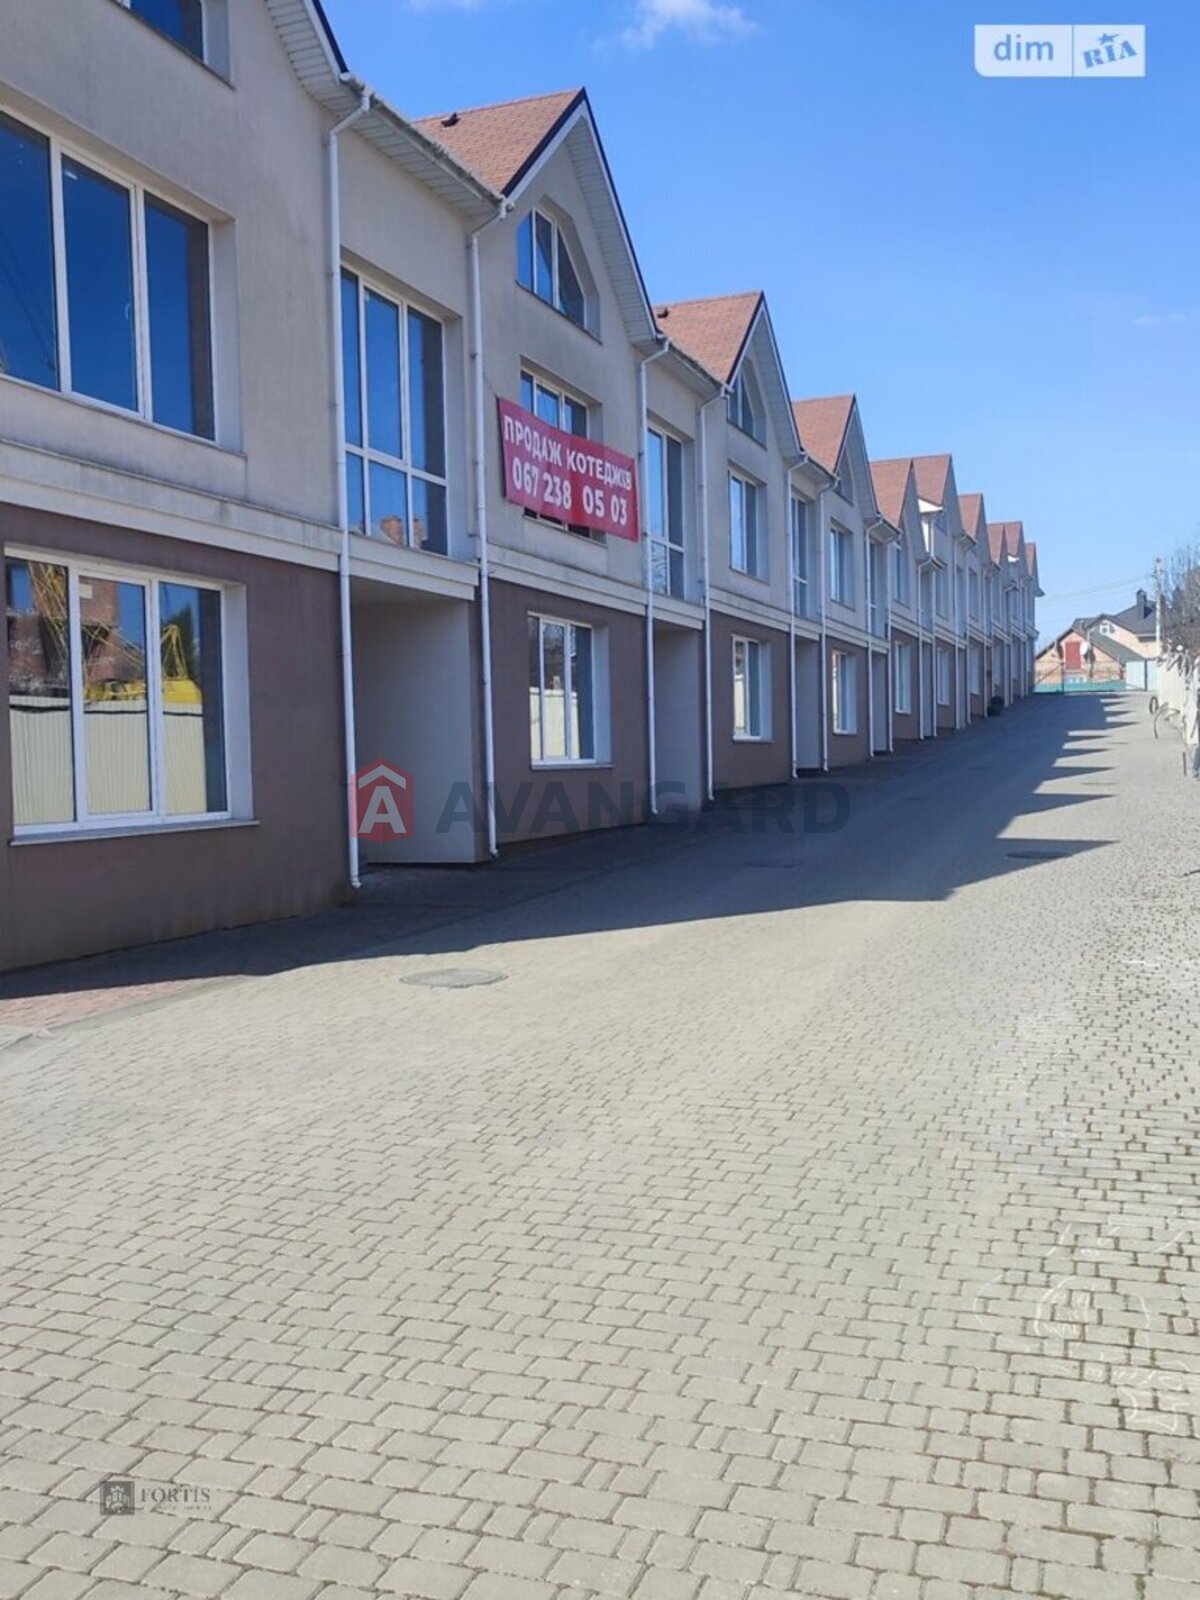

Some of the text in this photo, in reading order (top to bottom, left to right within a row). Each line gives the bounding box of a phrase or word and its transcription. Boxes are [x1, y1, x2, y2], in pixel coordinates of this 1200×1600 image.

[503, 414, 562, 467] ПРОДАЖ
[512, 457, 628, 526] 067 238 05 03
